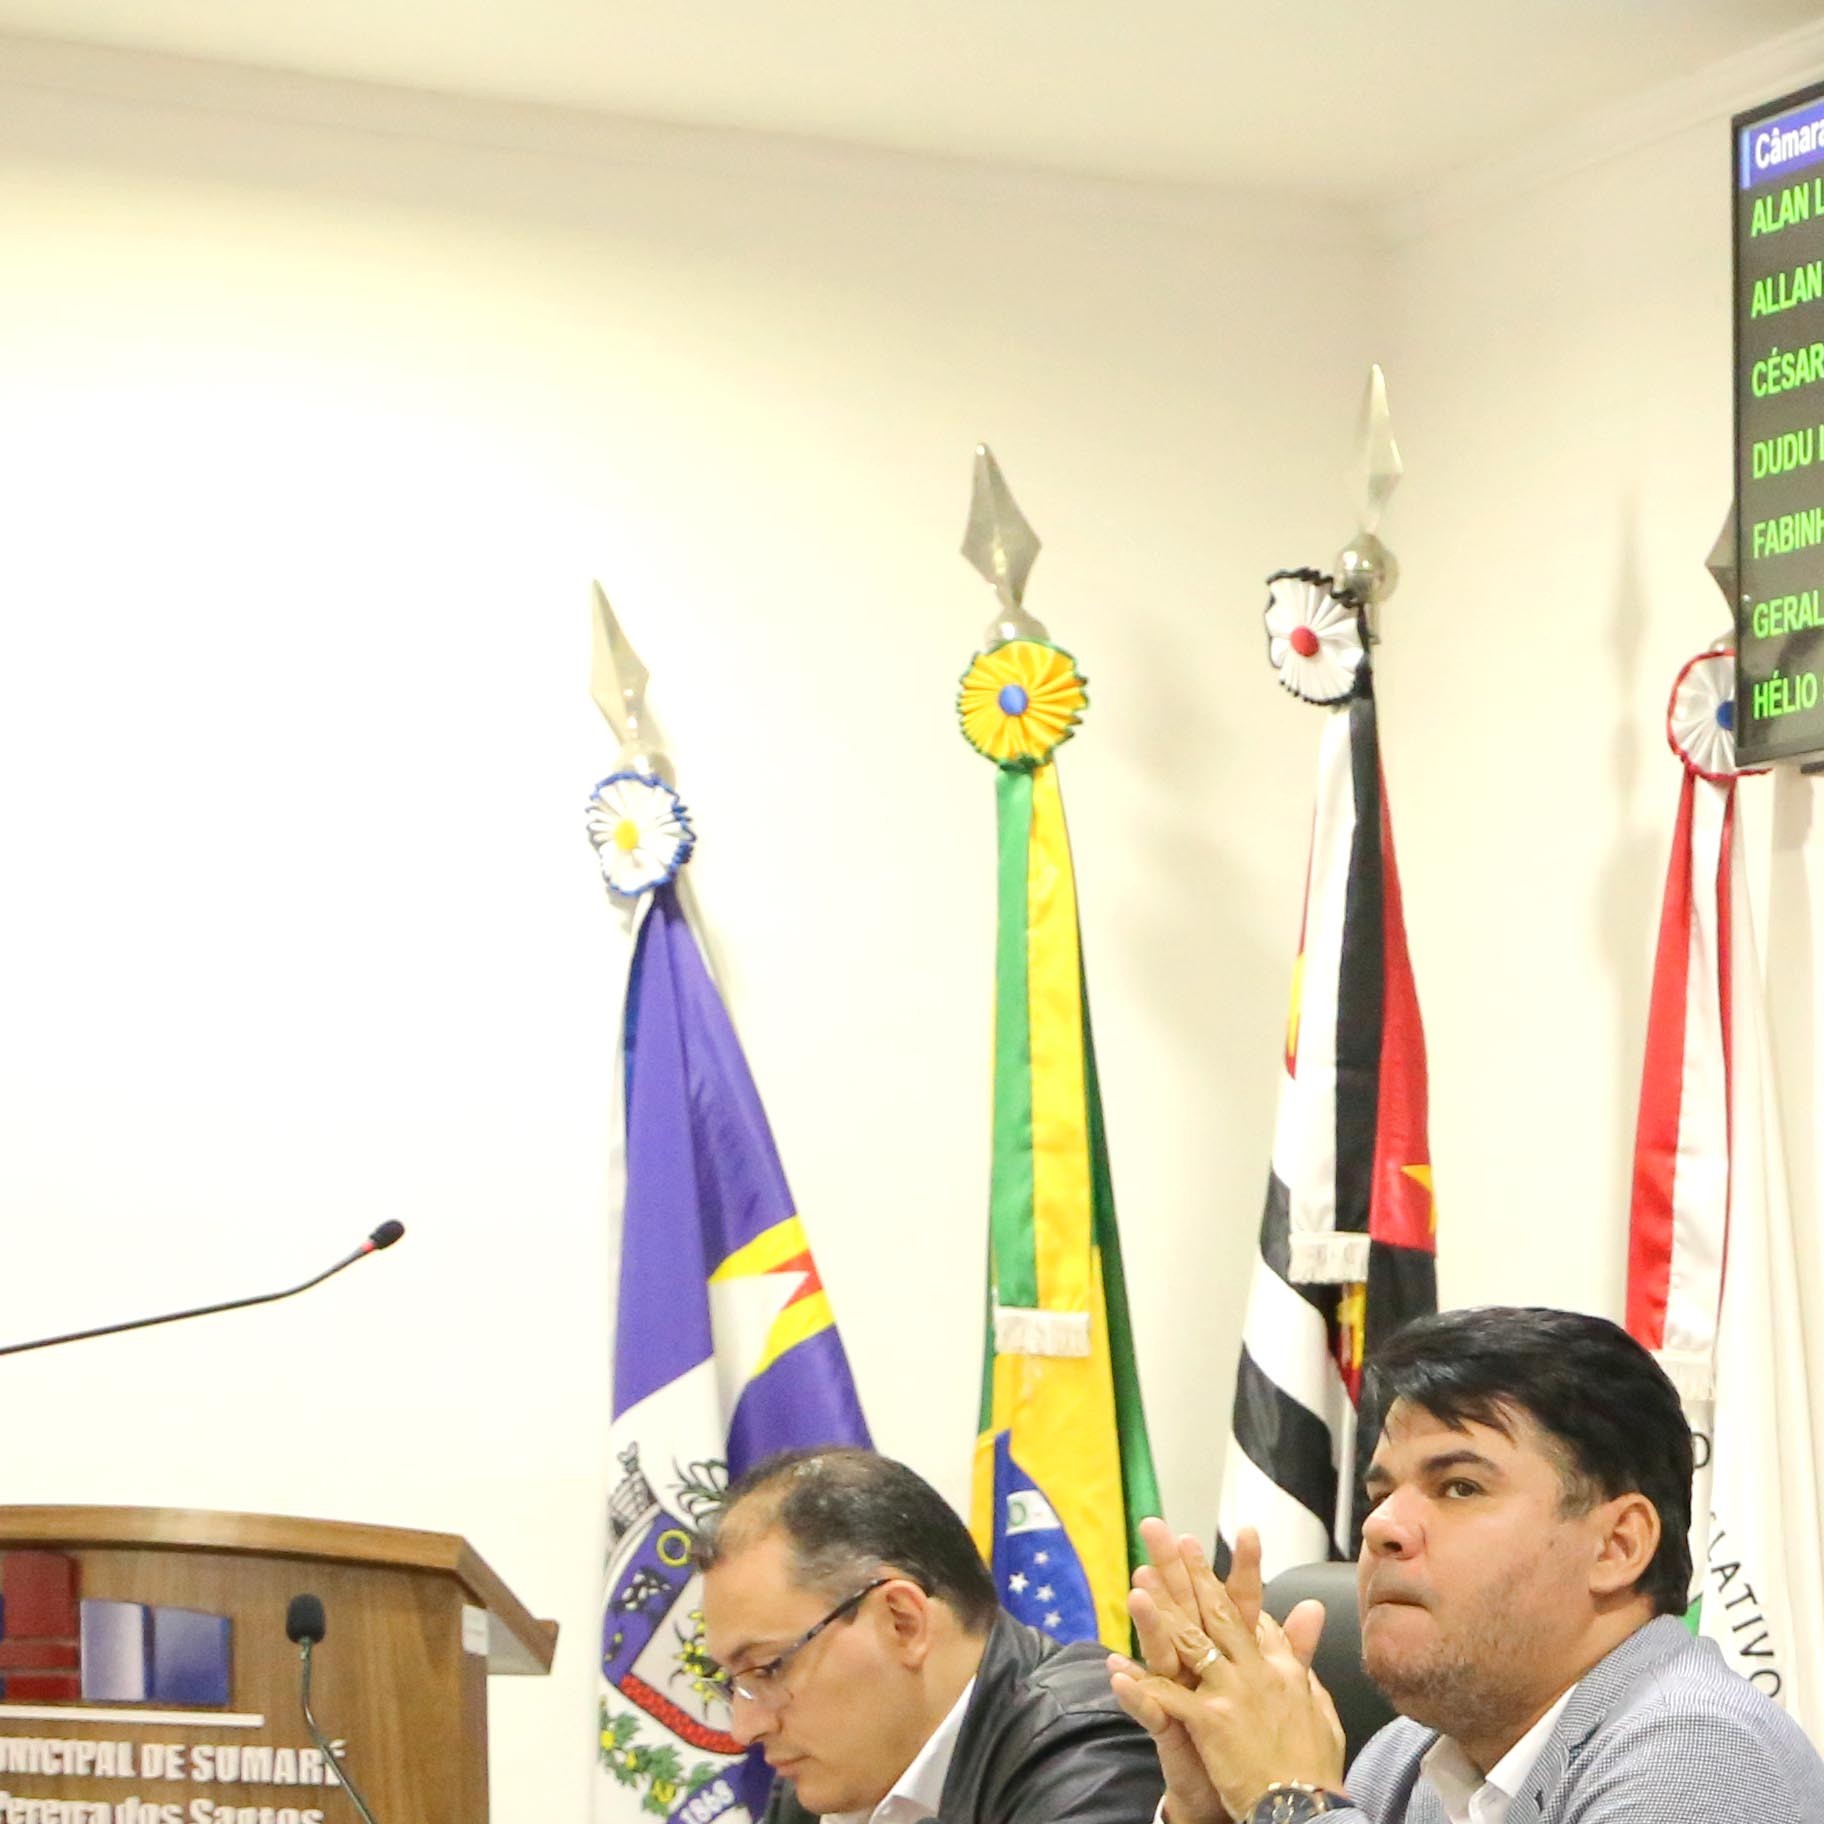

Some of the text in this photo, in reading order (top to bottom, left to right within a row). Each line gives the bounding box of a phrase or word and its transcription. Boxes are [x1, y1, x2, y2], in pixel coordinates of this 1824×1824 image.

[1751, 182, 1809, 237] ALAN
[1751, 261, 1823, 319] ALLAN
[1752, 428, 1813, 480] DUDU
[1753, 670, 1818, 720] HÉLIO
[141, 1743, 186, 1780] DE
